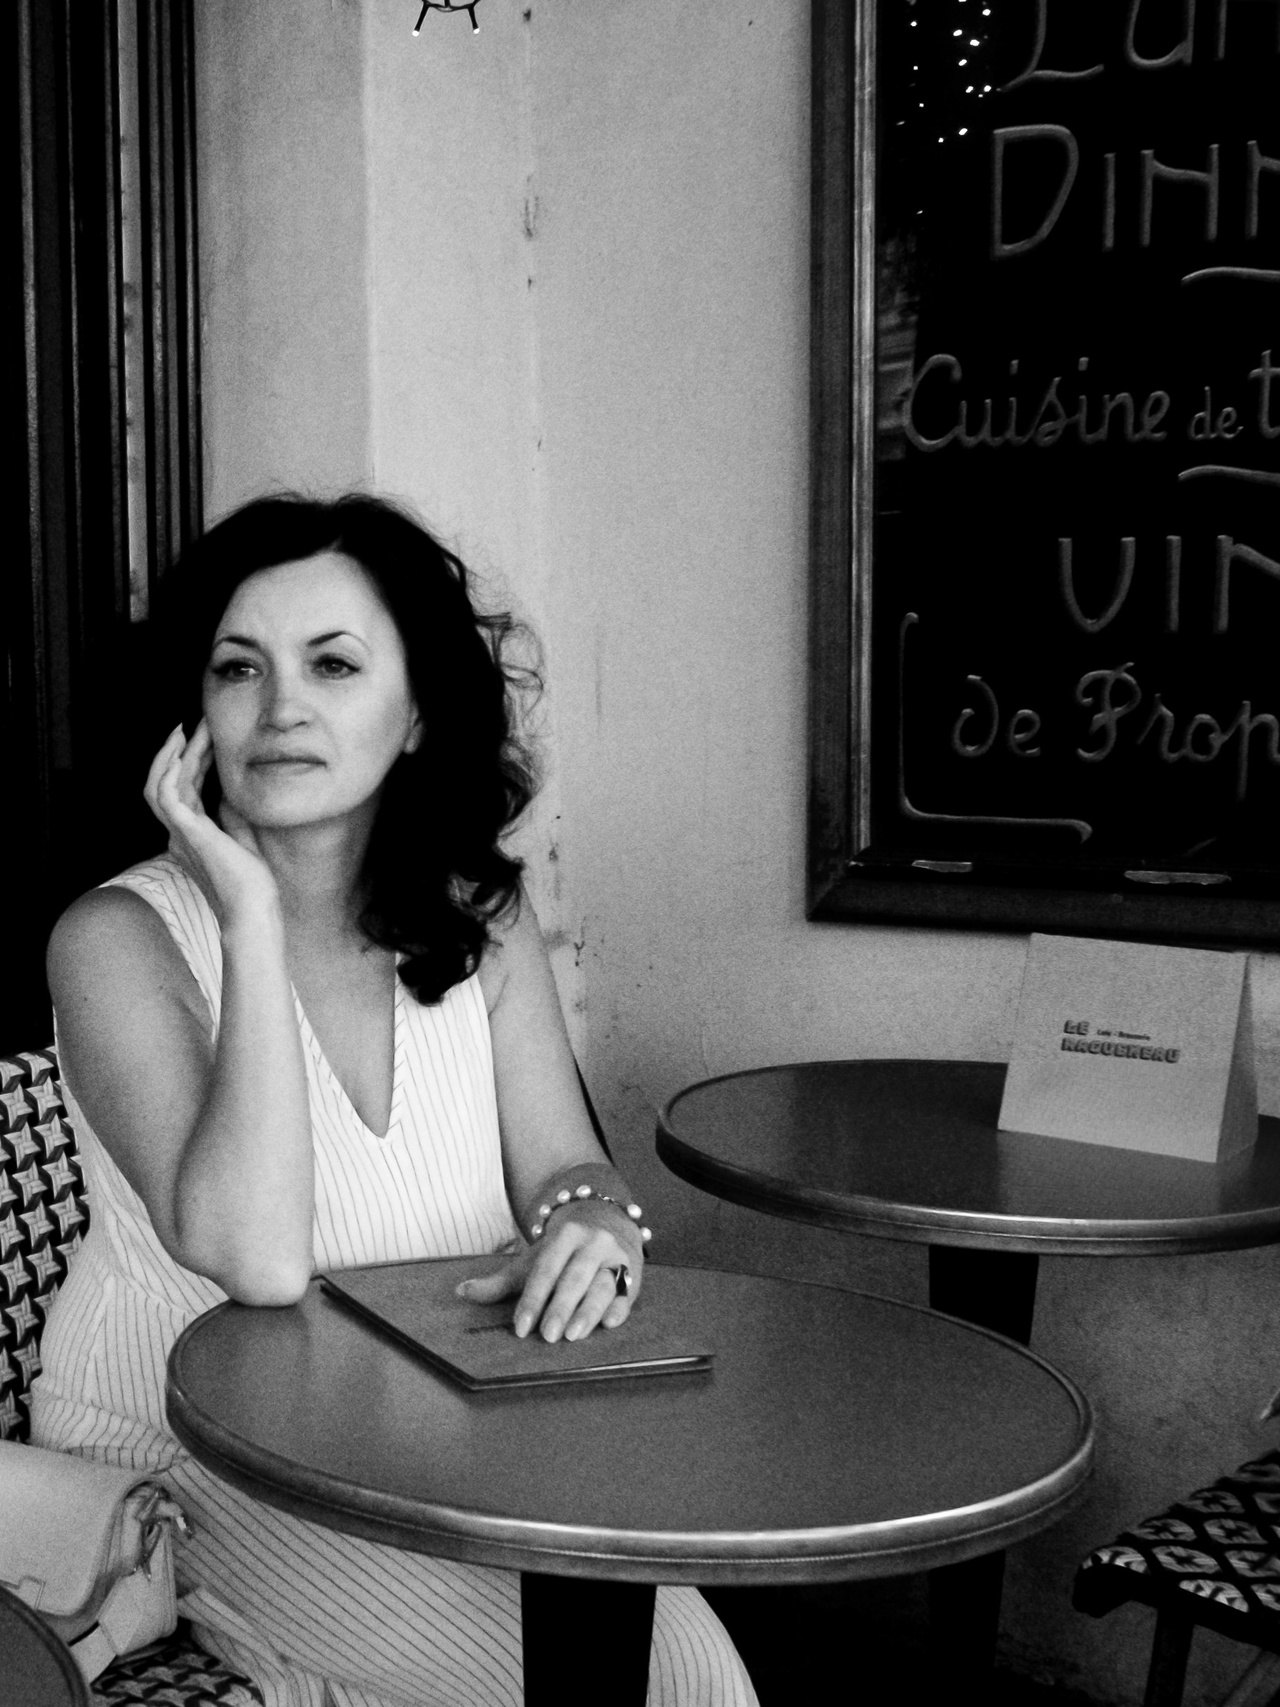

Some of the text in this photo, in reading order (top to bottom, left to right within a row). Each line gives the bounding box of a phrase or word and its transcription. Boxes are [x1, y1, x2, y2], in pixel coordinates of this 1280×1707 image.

[904, 353, 1171, 453] Cuisine
[1188, 386, 1244, 440] de
[951, 674, 1041, 758] de
[1065, 1020, 1090, 1035] LE
